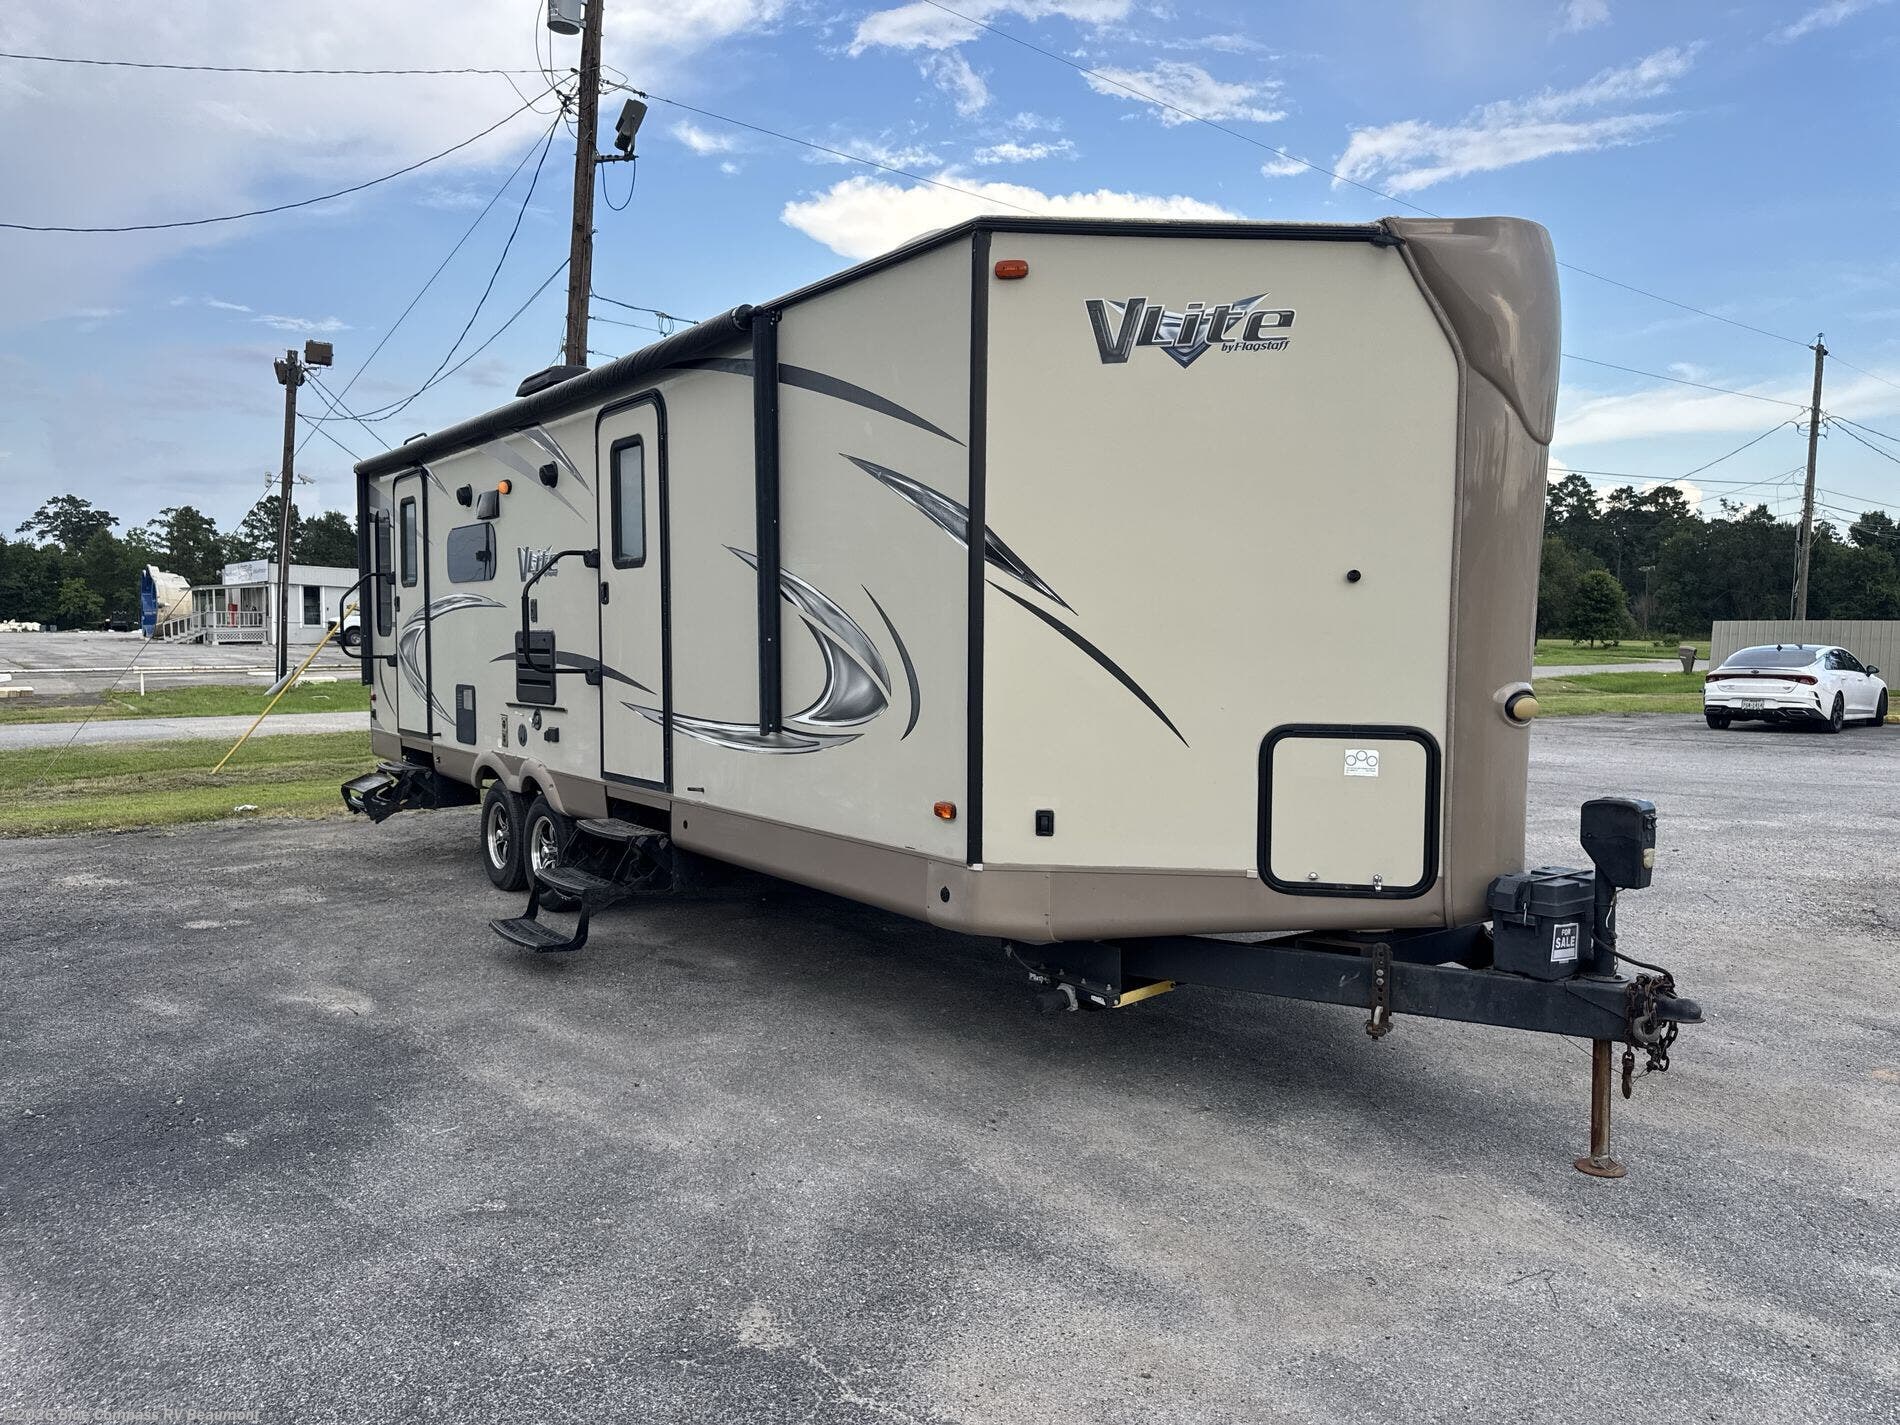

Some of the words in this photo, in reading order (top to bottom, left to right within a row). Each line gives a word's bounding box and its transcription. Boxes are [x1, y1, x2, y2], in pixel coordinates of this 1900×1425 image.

[1221, 342, 1234, 353] by
[1234, 340, 1290, 352] Flagstaff
[1555, 936, 1575, 948] SALE
